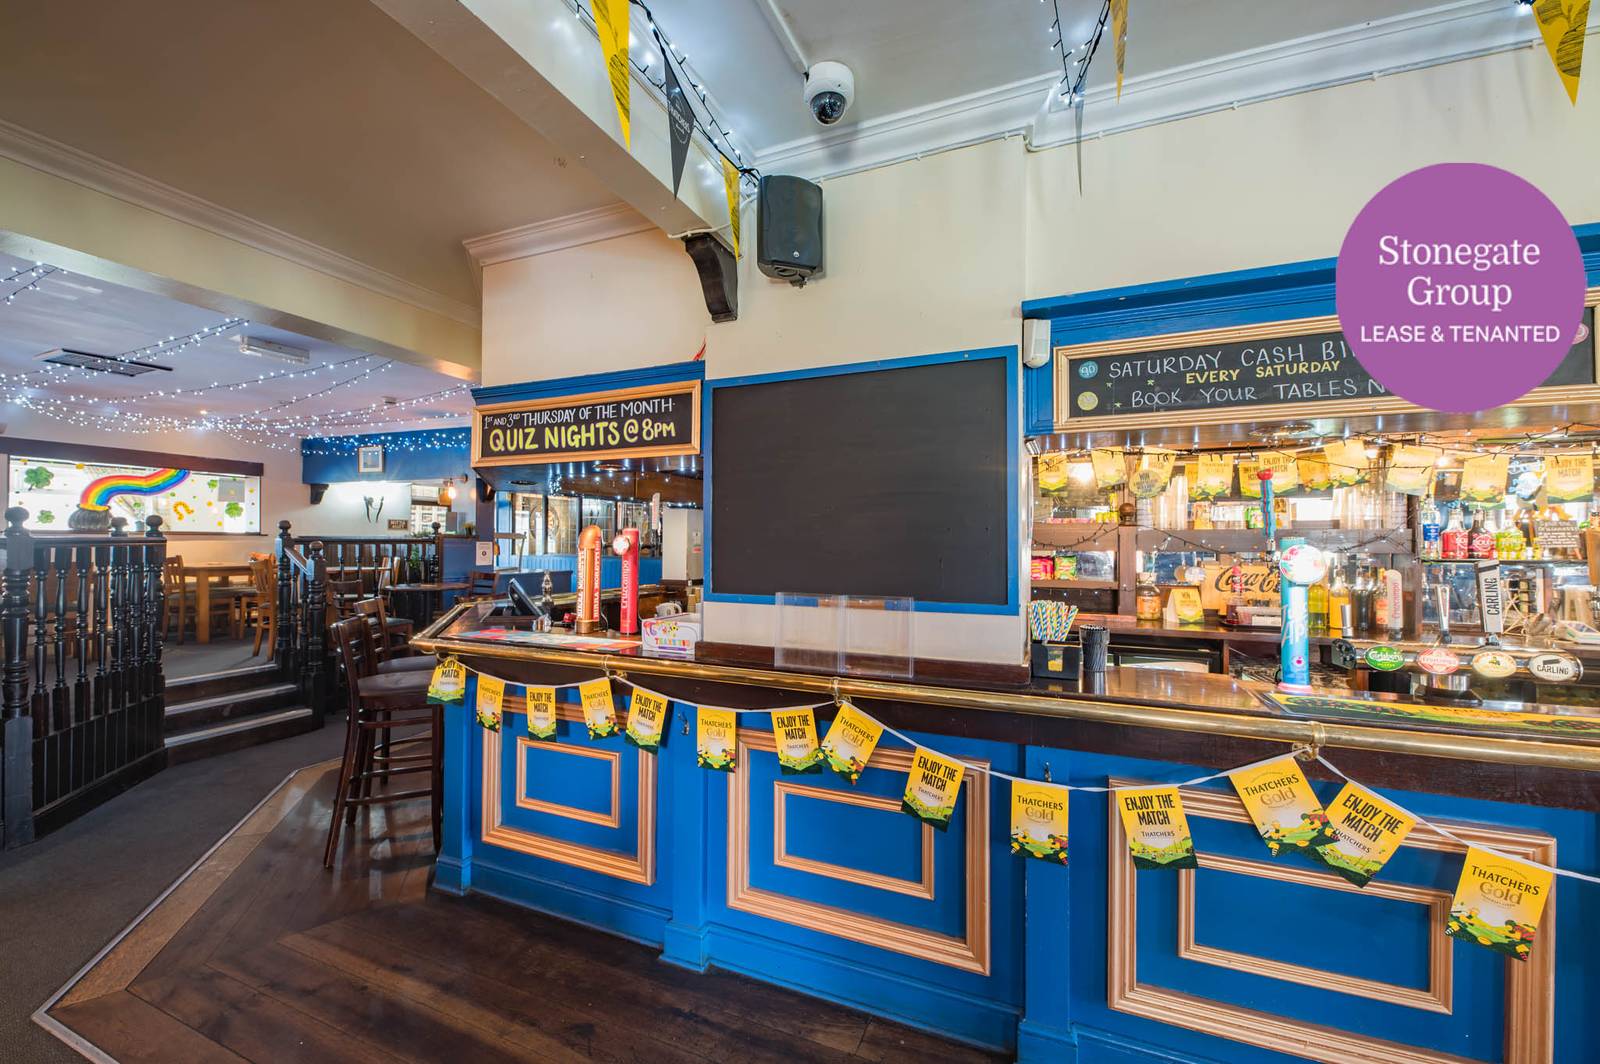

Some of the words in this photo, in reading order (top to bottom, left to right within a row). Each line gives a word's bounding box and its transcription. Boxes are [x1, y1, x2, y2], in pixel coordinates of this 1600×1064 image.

[1108, 350, 1223, 379] SATURDAY
[1241, 343, 1304, 368] CASH
[1185, 368, 1240, 385] EVERY
[1255, 360, 1341, 379] SATURDAY
[1132, 388, 1182, 408] BOOK
[1200, 383, 1258, 404] YOUR
[1273, 378, 1358, 400] TABLES
[493, 417, 507, 427] AND
[522, 409, 576, 427] THURSDAY
[579, 407, 592, 420] OF
[594, 405, 617, 420] THE
[489, 427, 538, 452] QUIZ
[544, 421, 620, 449] NIGHTS
[623, 418, 639, 443] @
[621, 560, 630, 609] Cruzcampo
[1485, 578, 1500, 616] CARLING
[1537, 665, 1569, 676] CARLING
[529, 692, 543, 703] ENJOY
[544, 693, 552, 703] THE
[635, 694, 652, 708] ENJOY
[652, 699, 663, 713] THE
[534, 703, 548, 713] MATCH
[637, 706, 656, 722] MATCH
[701, 718, 732, 729] THATCHERS
[777, 715, 796, 729] ENJOY
[797, 714, 810, 727] THE
[840, 715, 875, 743] THATCHERS
[785, 727, 807, 741] MATCH
[841, 727, 865, 748] Gold
[917, 756, 942, 774] ENJOY
[943, 767, 959, 783] THE
[920, 772, 947, 792] MATCH
[1242, 774, 1300, 797] THATCHERS
[918, 786, 944, 801] THATCHERS
[1017, 795, 1064, 811] THATCHERS
[1124, 795, 1154, 811] ENJOY
[1157, 794, 1175, 809] THE
[1260, 787, 1297, 806] Gold
[1025, 806, 1055, 821] Gold
[1137, 811, 1171, 826] MATCH
[1342, 793, 1382, 822] ENJOY
[1384, 812, 1404, 836] THE
[1141, 830, 1175, 838] THATCHERS
[1341, 812, 1383, 843] MATCH
[1334, 828, 1372, 854] THATCHERS
[1471, 865, 1540, 896] THATCHERS
[1480, 881, 1523, 905] Gold
